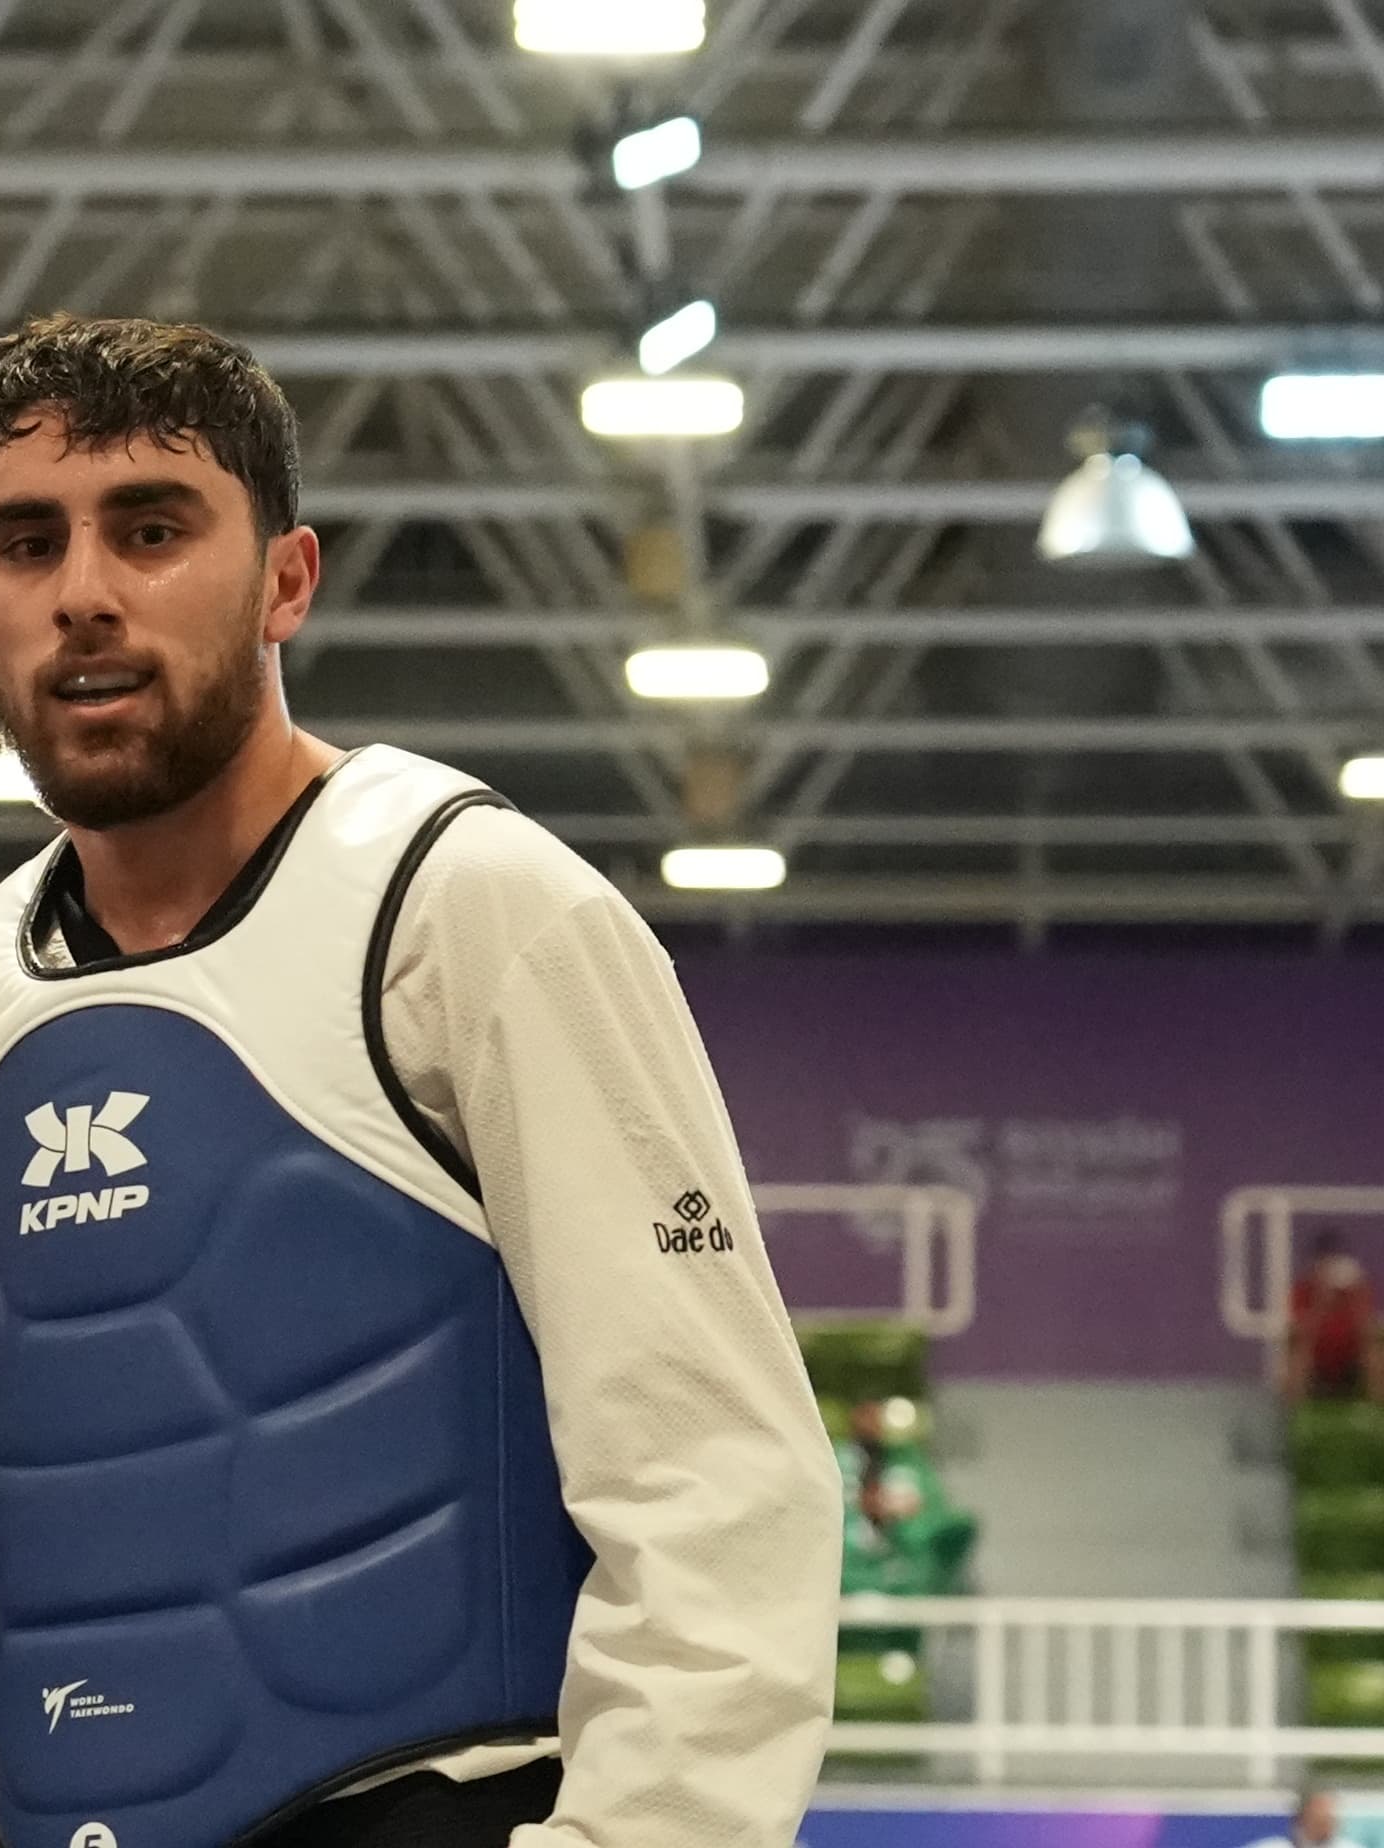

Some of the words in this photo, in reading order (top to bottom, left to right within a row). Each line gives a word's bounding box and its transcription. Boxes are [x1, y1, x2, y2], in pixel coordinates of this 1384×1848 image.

[20, 1184, 150, 1235] KPNP
[70, 1694, 104, 1707] WORLD
[70, 1703, 135, 1718] TAEKWONDO
